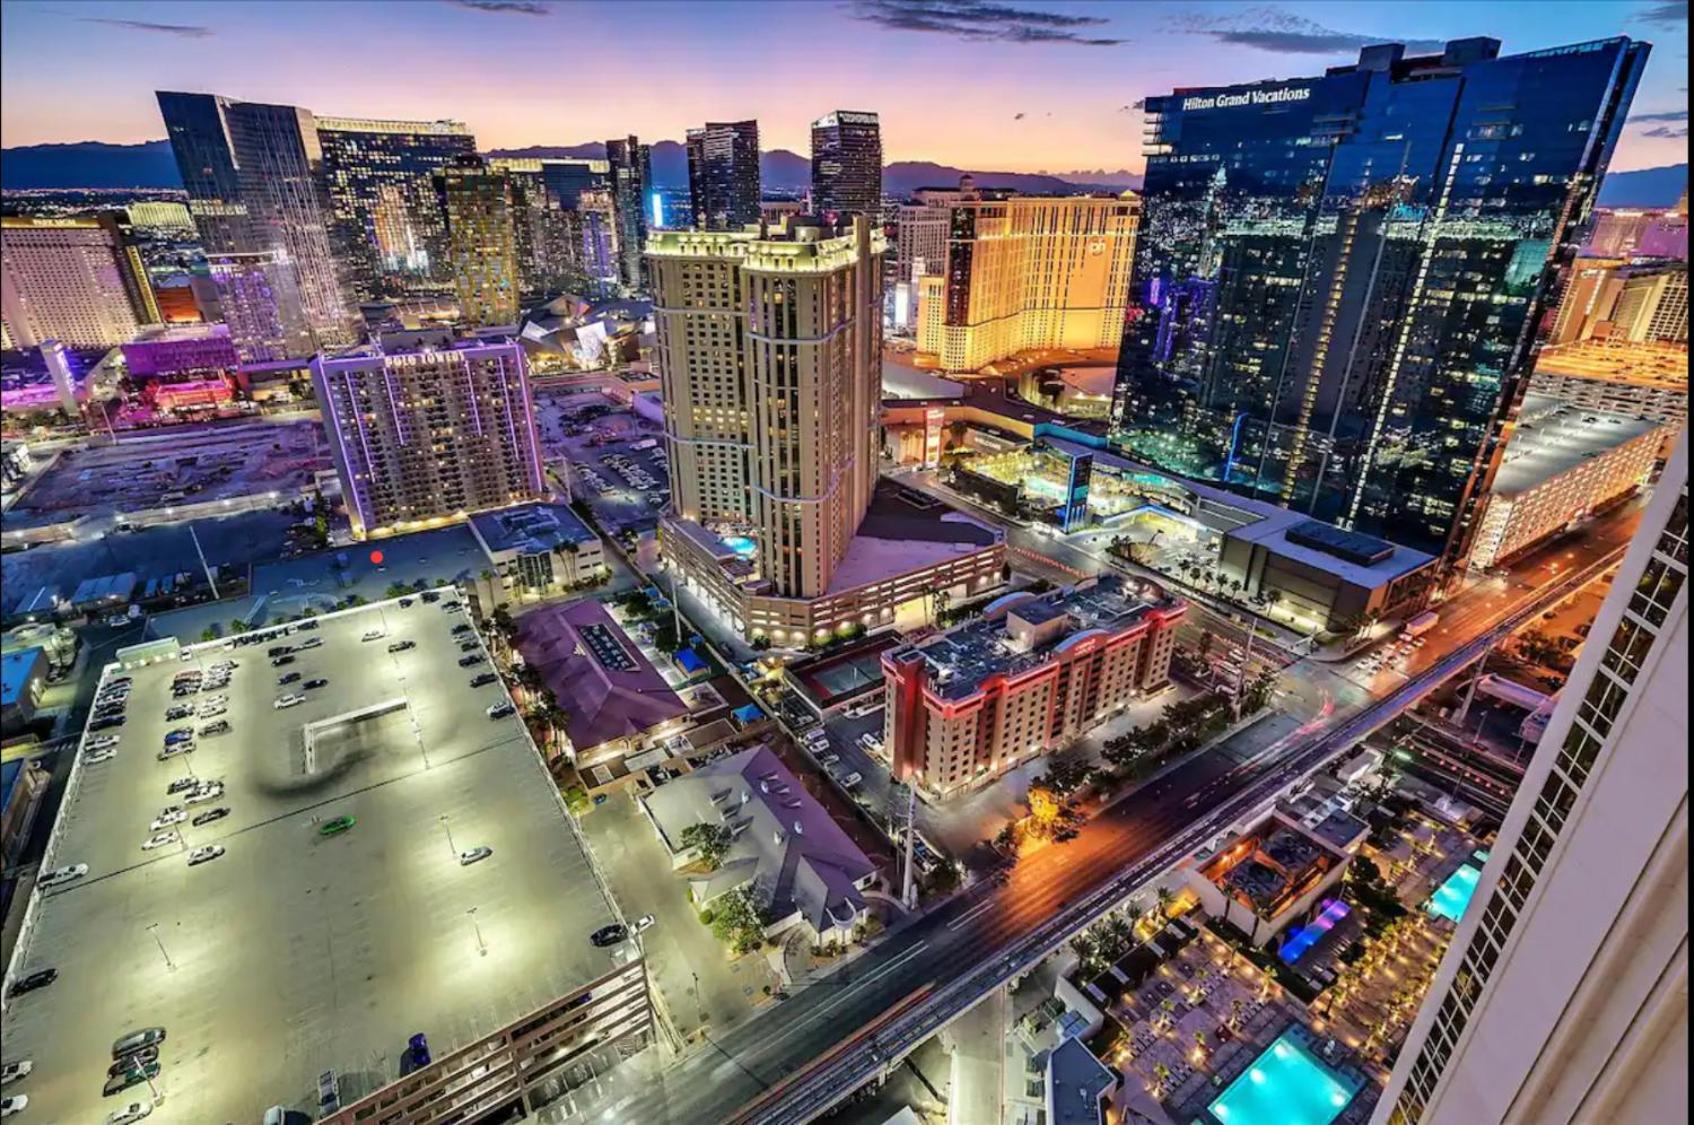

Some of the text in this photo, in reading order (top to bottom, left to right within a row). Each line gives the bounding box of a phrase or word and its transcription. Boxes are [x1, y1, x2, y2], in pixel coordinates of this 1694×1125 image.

[1183, 87, 1310, 110] Hilton Grand Vacations
